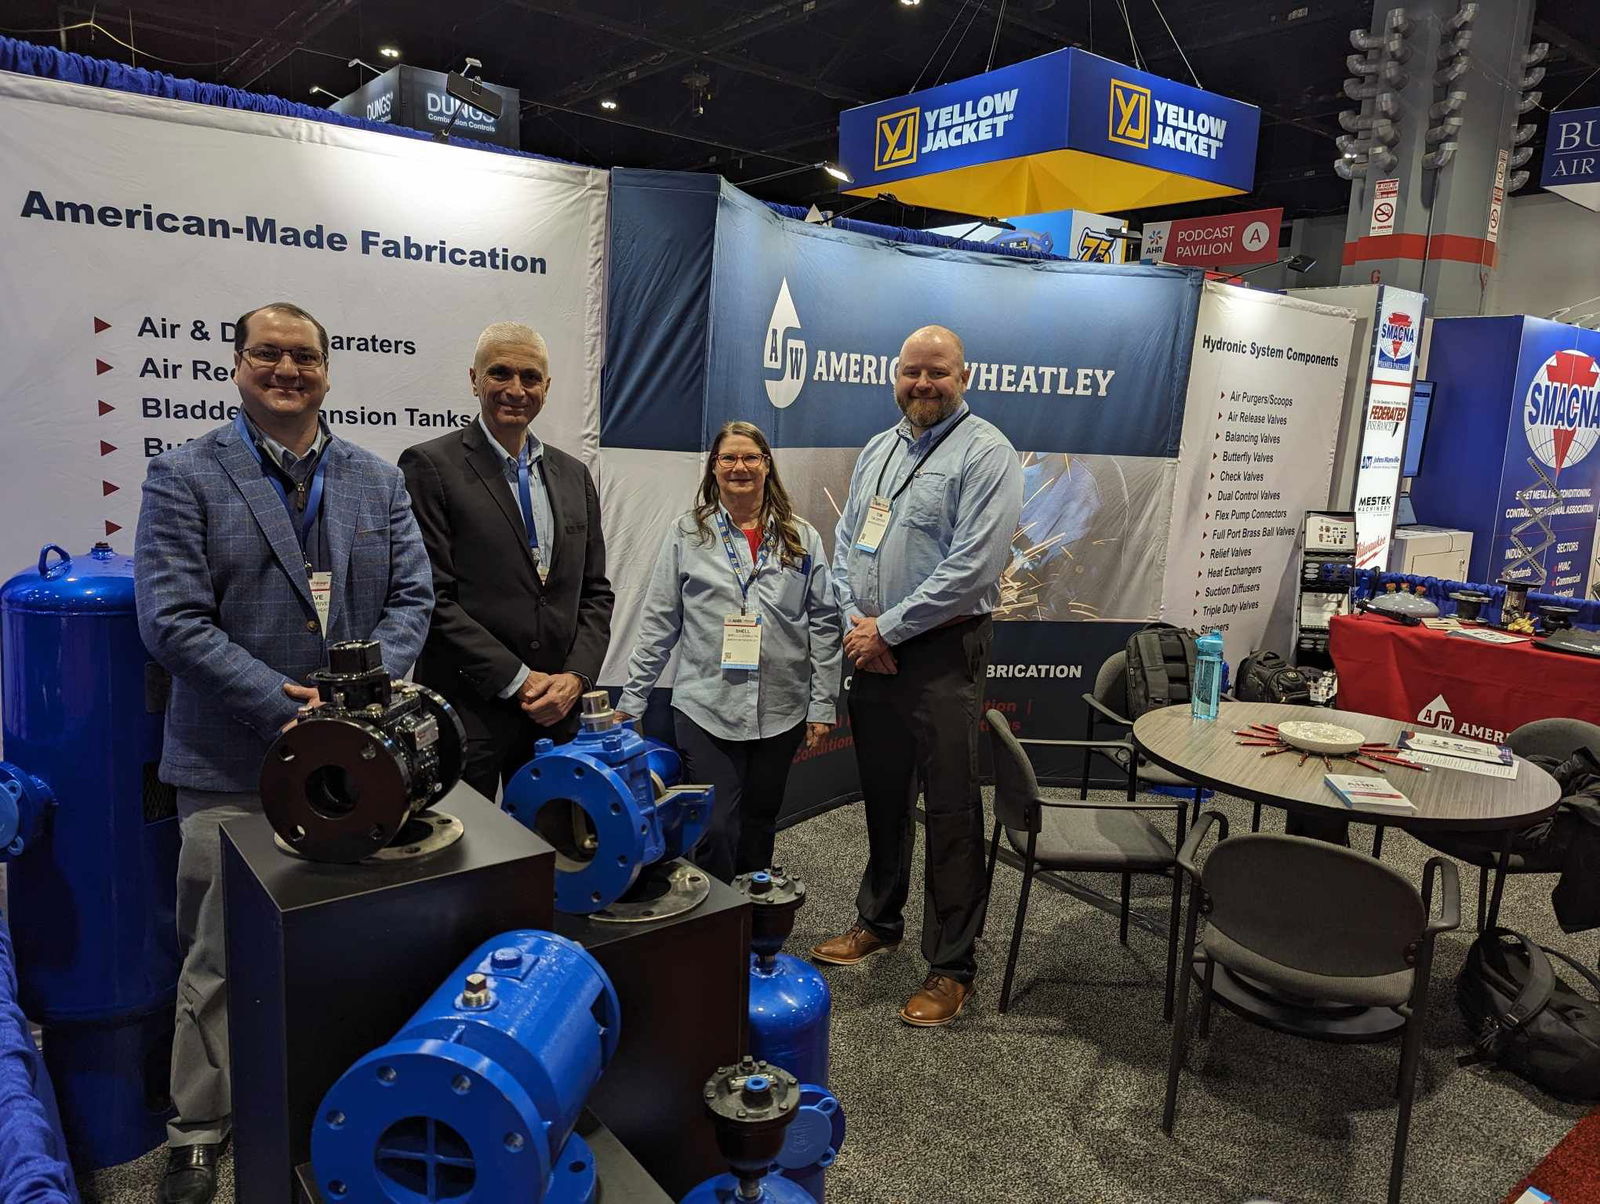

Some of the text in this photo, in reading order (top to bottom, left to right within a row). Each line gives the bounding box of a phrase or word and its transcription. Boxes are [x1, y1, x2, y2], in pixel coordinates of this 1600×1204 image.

[924, 88, 1019, 131] YELLOW
[468, 121, 496, 133] Controls
[1154, 99, 1227, 140] YELLOW
[1551, 157, 1595, 177] AIR
[21, 190, 547, 274] American-Made Fabrication
[1178, 226, 1261, 244] PODCAST A
[1146, 246, 1162, 255] AHR
[1176, 242, 1233, 258] PAVILION
[137, 316, 181, 339] Air
[190, 320, 211, 341] &
[1381, 324, 1414, 343] SMACNA
[1202, 334, 1339, 367] Hydronic System Components
[139, 357, 182, 379] Air
[1230, 391, 1293, 408] Air Purgers/Scoops
[1528, 382, 1600, 429] SMACNA
[405, 408, 471, 427] Tanks
[1228, 412, 1287, 425] Air Release Valves
[1370, 405, 1406, 421] FEDERATED
[1225, 431, 1280, 445] Balancing Valves
[1222, 451, 1274, 464] Butterfly Valves
[1220, 471, 1264, 482] Check Valves
[1218, 490, 1280, 501] Dual Control Valves
[1359, 496, 1391, 506] MESTEK
[1215, 509, 1287, 521] Flex Pump Connectors
[1212, 526, 1295, 539] Full Port Brass Ball Valves
[1210, 547, 1252, 559] Relief Valves
[1557, 541, 1579, 553] SECTORS
[1207, 565, 1262, 578] Heat Exchangers
[1205, 583, 1260, 597] Suction Diffusers
[1203, 601, 1259, 617] Triple Duty Valves
